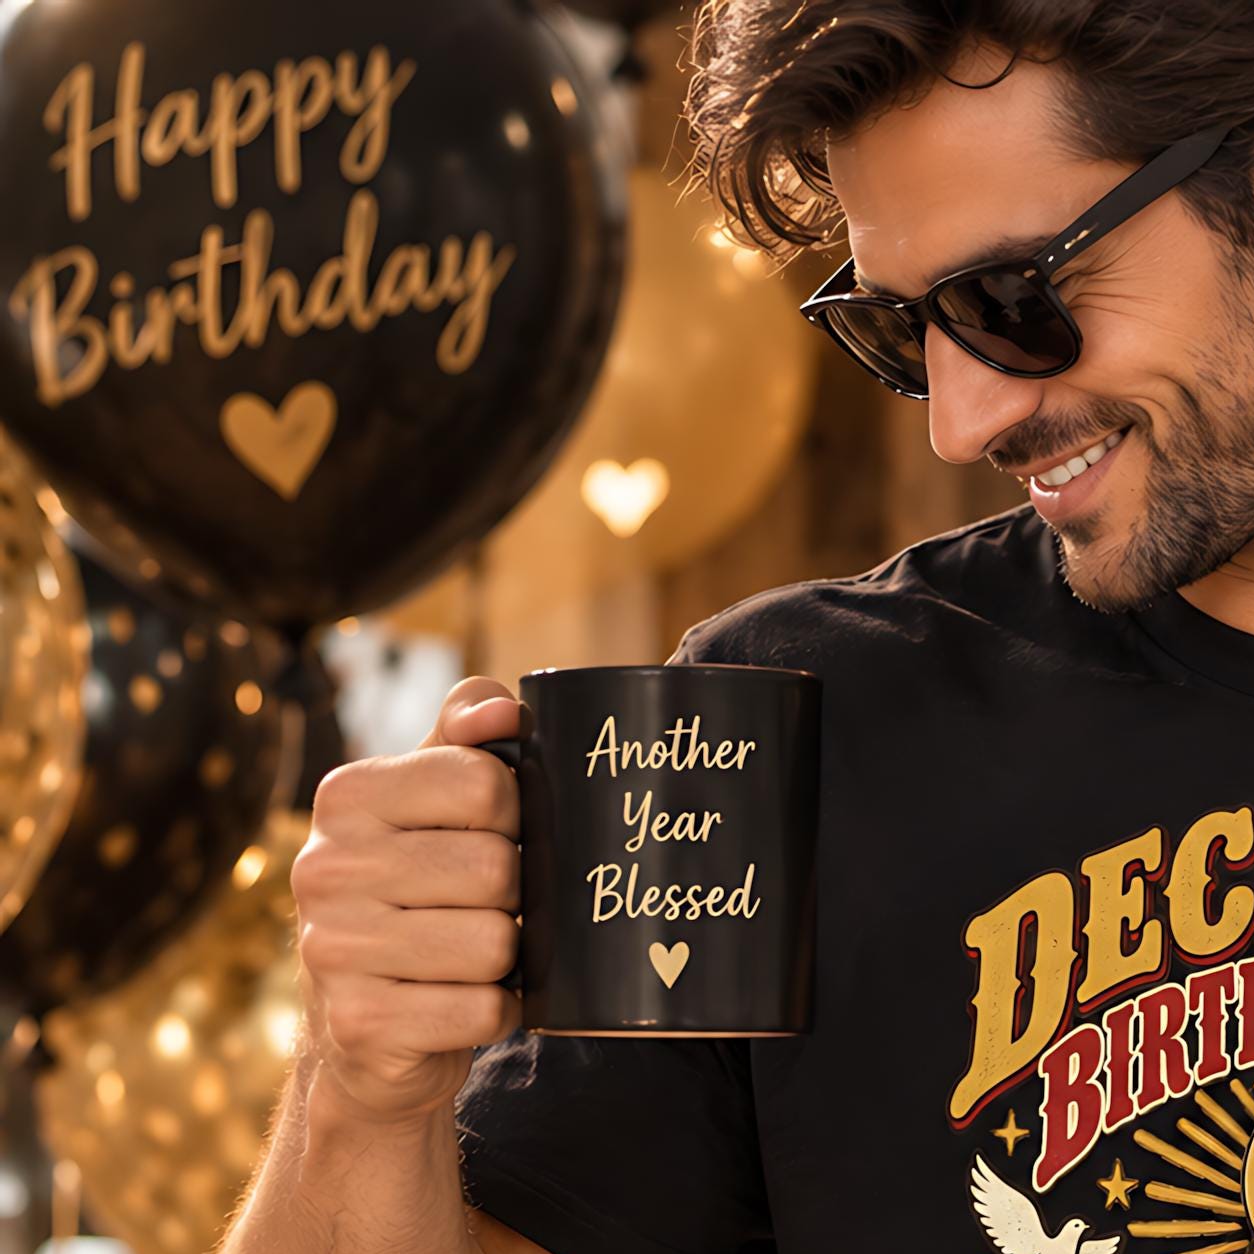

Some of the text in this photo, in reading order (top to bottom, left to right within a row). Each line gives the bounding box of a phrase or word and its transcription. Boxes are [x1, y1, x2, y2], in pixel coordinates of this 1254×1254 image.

[42, 41, 417, 222] Happy
[11, 189, 516, 407] Birthday
[586, 715, 756, 777] Another
[623, 790, 723, 853] Year
[586, 863, 761, 923] Blessed
